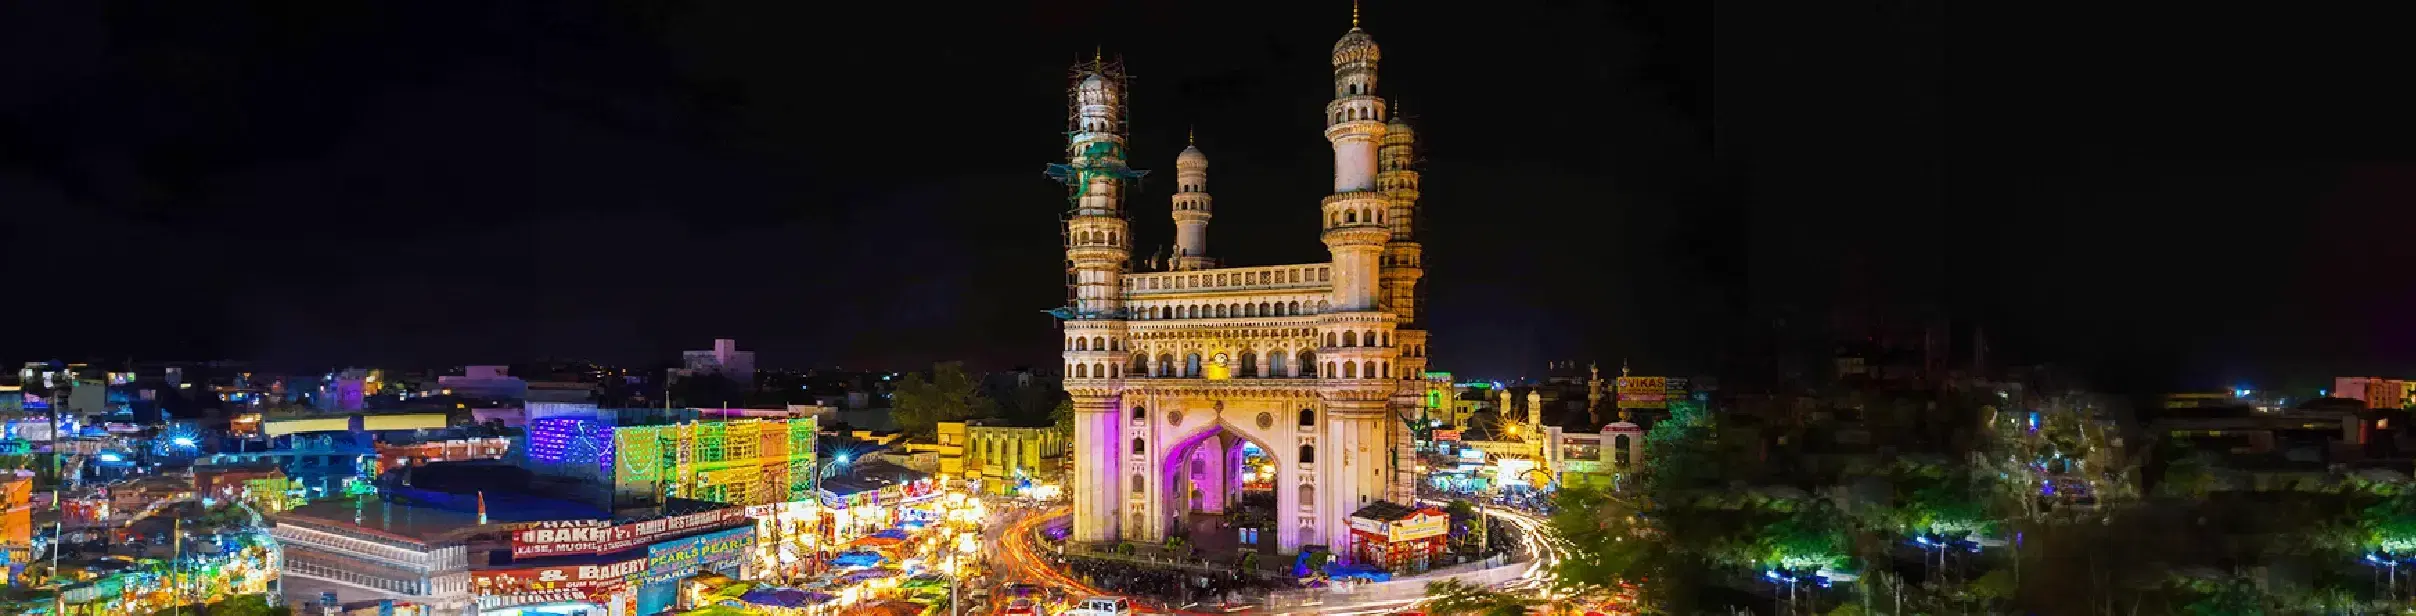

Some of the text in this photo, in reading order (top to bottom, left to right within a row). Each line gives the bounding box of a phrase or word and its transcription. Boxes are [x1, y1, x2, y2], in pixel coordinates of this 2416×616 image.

[1629, 378, 1664, 388] VIKAS
[635, 519, 667, 536] FAMILY
[701, 536, 754, 556] PEARLS
[650, 548, 699, 567] PEARLS
[578, 557, 648, 581] BAKERY
